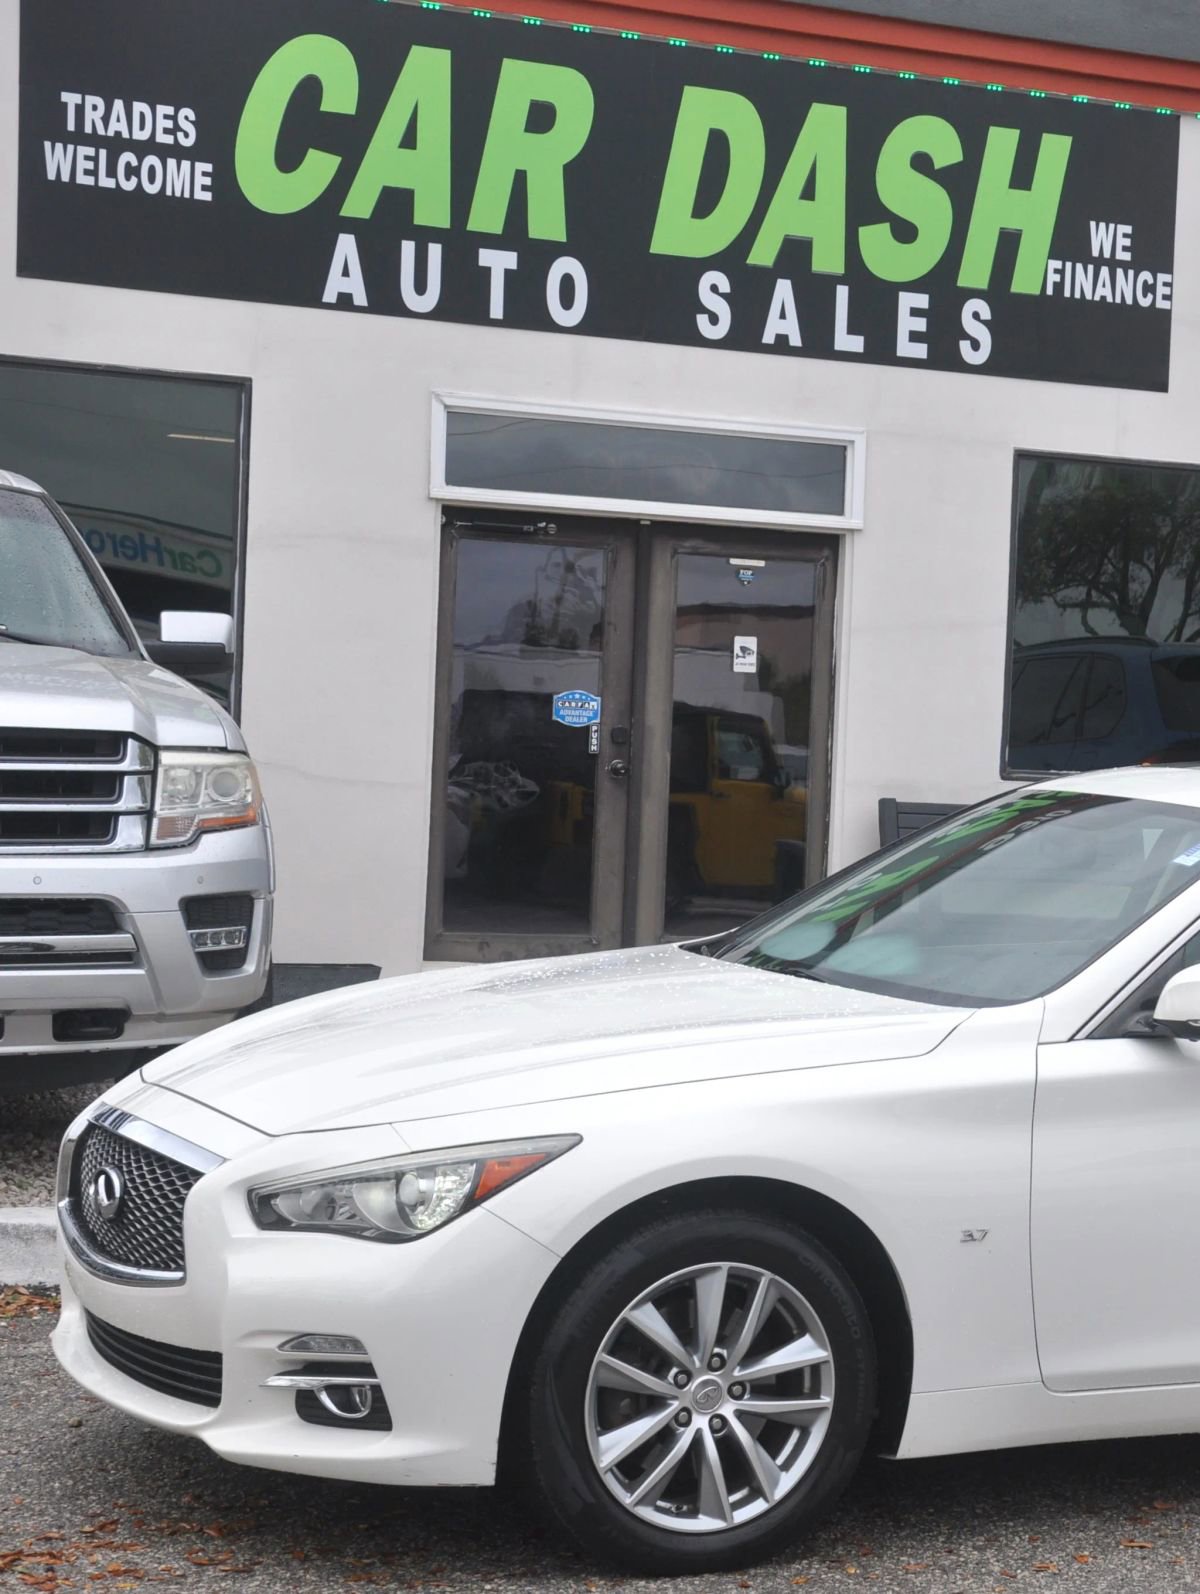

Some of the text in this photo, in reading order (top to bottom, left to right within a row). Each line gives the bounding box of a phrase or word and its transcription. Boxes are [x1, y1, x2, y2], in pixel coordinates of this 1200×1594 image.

[60, 91, 197, 147] TRADES
[43, 141, 213, 201] WELCOME
[234, 34, 1072, 295] CAR DASH
[1089, 220, 1133, 261] WE
[321, 233, 993, 365] AUTO SALES
[1046, 259, 1173, 310] FINANCE
[557, 701, 598, 709] CARFAX
